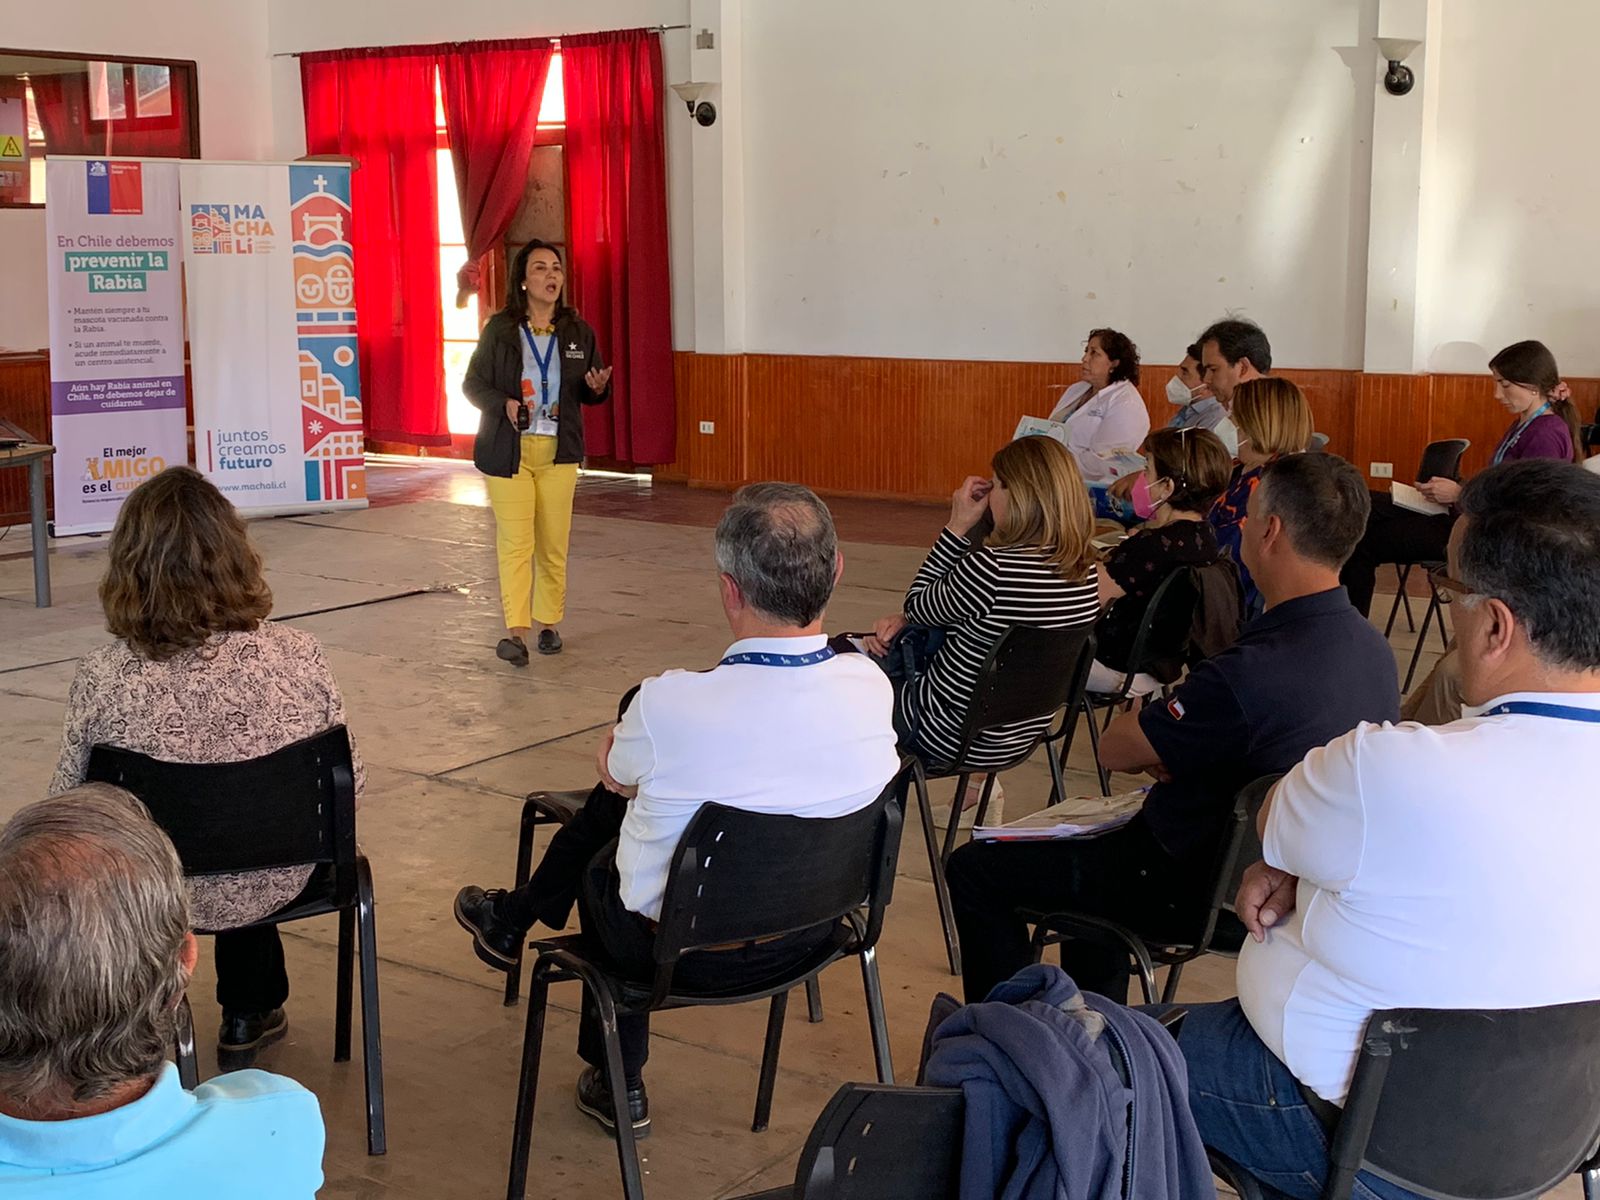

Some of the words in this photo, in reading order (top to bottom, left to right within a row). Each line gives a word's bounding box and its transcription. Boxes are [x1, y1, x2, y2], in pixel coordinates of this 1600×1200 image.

[234, 204, 265, 219] MA
[233, 221, 274, 236] CHA
[57, 236, 74, 247] En
[77, 235, 112, 247] Chile
[115, 235, 175, 247] debemos
[69, 252, 144, 272] prevenir
[147, 252, 164, 267] la
[93, 274, 143, 290] Rabia
[104, 307, 136, 315] siempre
[73, 316, 106, 324] mascota
[144, 314, 169, 322] contra
[73, 325, 81, 333] la
[95, 340, 122, 348] animal
[74, 350, 99, 358] acude
[99, 348, 161, 357] inmediatamente
[74, 359, 86, 367] un
[90, 383, 106, 392] hay
[107, 382, 131, 390] Rabia
[131, 380, 160, 390] animal
[66, 393, 92, 402] Chile,
[105, 390, 143, 400] debemos
[143, 389, 165, 398] dejar
[165, 388, 177, 396] de
[100, 399, 145, 409] cuidarnos.
[217, 429, 269, 446] juntos
[103, 448, 114, 457] El
[116, 446, 147, 458] mejor
[219, 443, 287, 456] creamos
[219, 457, 273, 470] futuro
[82, 484, 97, 493] es
[100, 480, 113, 492] el
